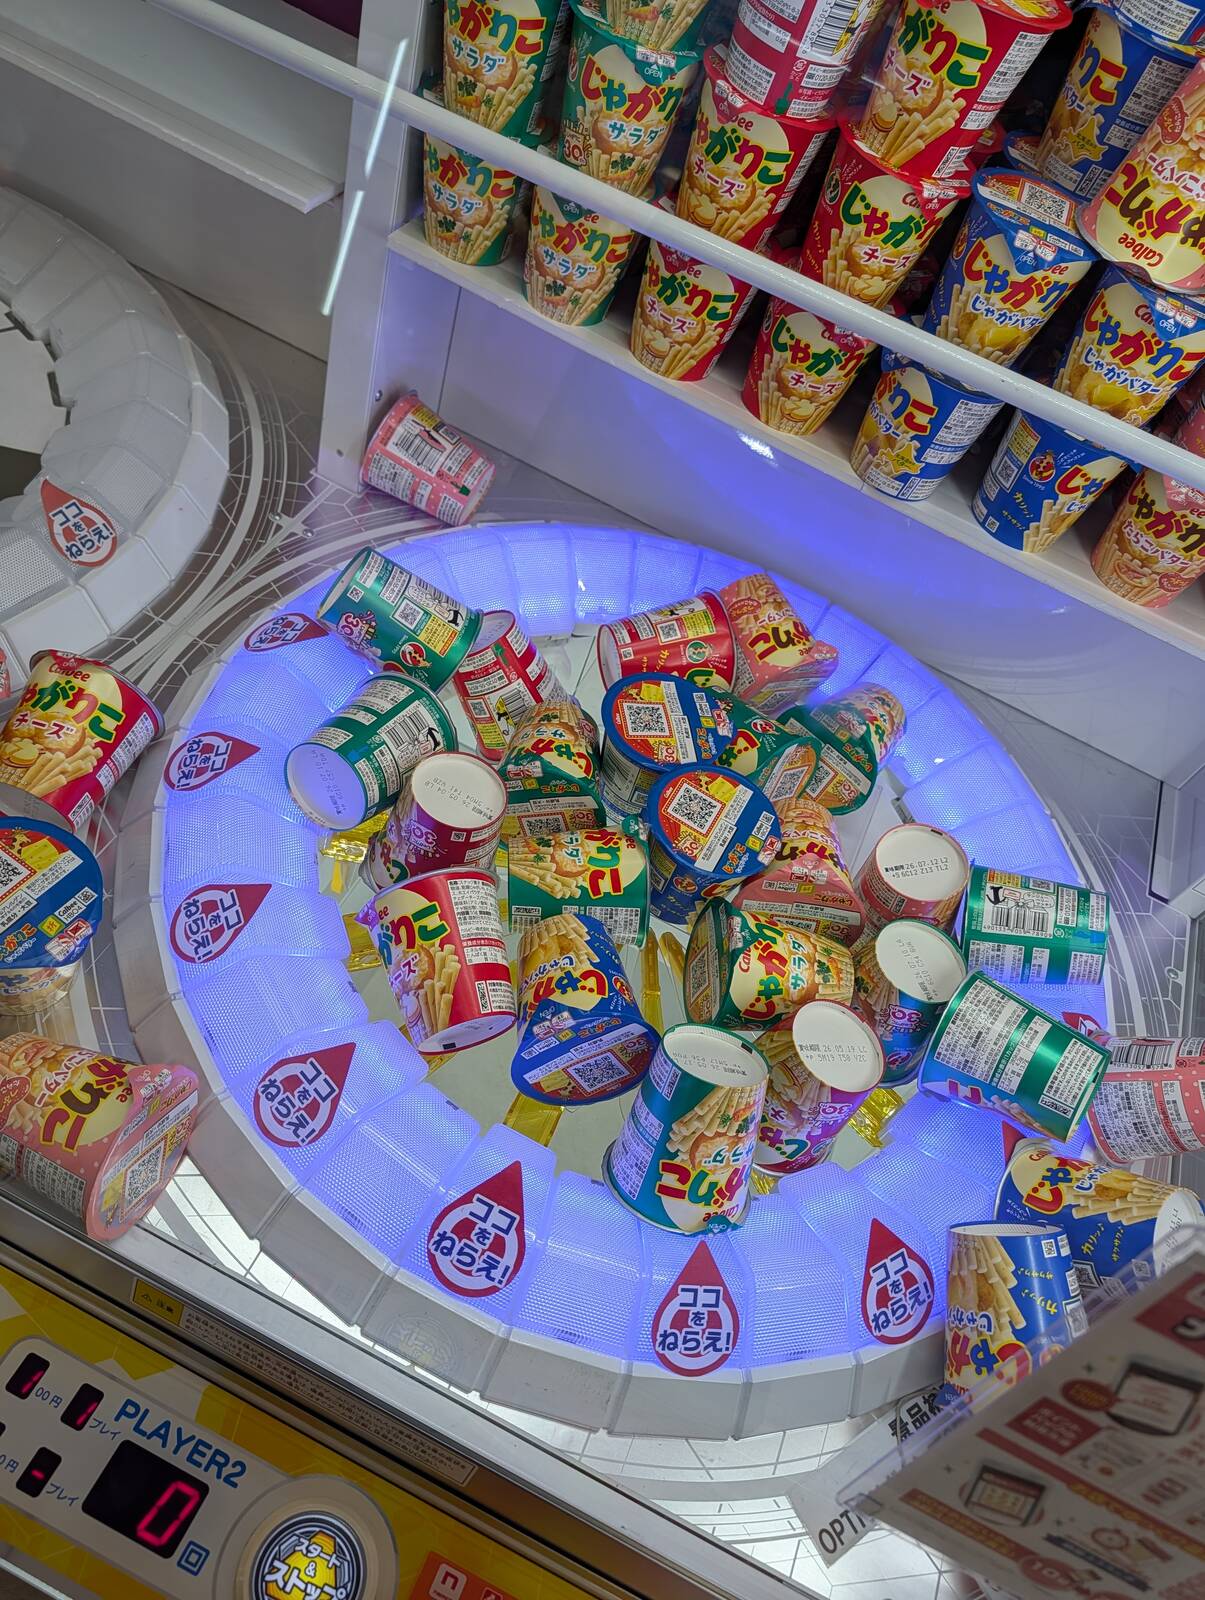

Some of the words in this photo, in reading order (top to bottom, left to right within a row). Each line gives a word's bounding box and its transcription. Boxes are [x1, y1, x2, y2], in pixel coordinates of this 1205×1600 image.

[452, 37, 505, 74] サラダ
[581, 54, 688, 122] じゃがり
[884, 50, 931, 97] チーズ
[608, 121, 664, 147] サラダ
[694, 158, 745, 199] チーズ
[433, 183, 482, 215] サラダ
[543, 247, 597, 279] サラダ
[862, 247, 919, 273] チーズ
[1019, 255, 1038, 266] OPEN
[1118, 232, 1164, 268] Calbee
[646, 298, 695, 335] チーズ
[1159, 319, 1177, 334] OPEN
[790, 373, 842, 395] チーズ
[1083, 346, 1162, 394] じゃがバター
[52, 501, 84, 528] ココ
[73, 519, 86, 534] を
[66, 526, 114, 563] ねらえ!
[1123, 519, 1192, 566] たらこバター
[14, 712, 76, 740] チーズ
[176, 738, 203, 788] ねらえ!
[199, 754, 212, 766] を
[210, 742, 231, 772] ココ
[57, 901, 79, 918] Calbee
[208, 913, 222, 930] を
[219, 890, 243, 930] ココ
[183, 898, 213, 961] ねらえ!
[790, 933, 807, 991] サラダ
[297, 1058, 339, 1101] ココ
[259, 1078, 316, 1145] ねらえ!
[296, 1088, 312, 1105] を
[469, 1195, 518, 1237] ココ
[475, 1227, 493, 1247] を
[433, 1233, 510, 1286] ねらえ!
[872, 1251, 909, 1286] ココ
[679, 1287, 723, 1309] ココ
[888, 1278, 904, 1295] を
[690, 1308, 707, 1327] を
[871, 1284, 933, 1335] ねらえ!
[656, 1330, 731, 1354] ねらえ!
[35, 1386, 63, 1409] 00円
[89, 1417, 122, 1441] プレイ
[114, 1398, 248, 1489] PLAYER2
[45, 1483, 80, 1507] プレイ
[136, 1480, 201, 1547] 0
[294, 1537, 342, 1569] スタート
[305, 1560, 318, 1579] &
